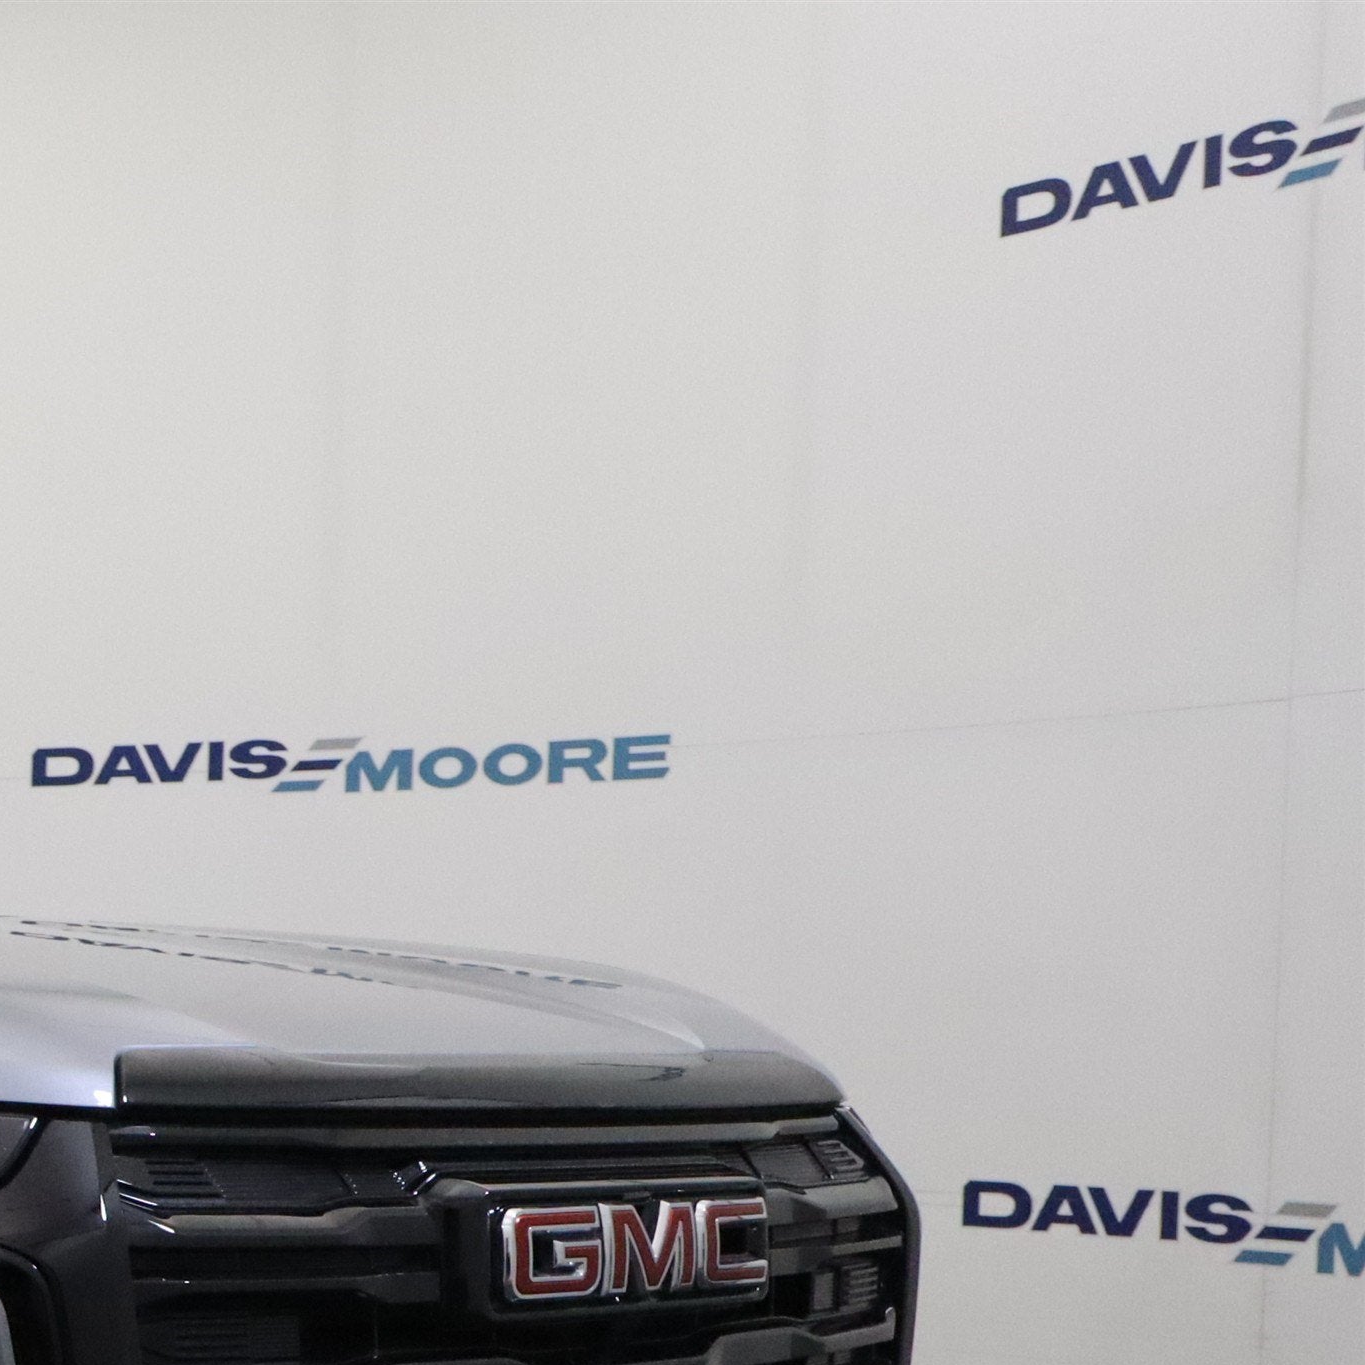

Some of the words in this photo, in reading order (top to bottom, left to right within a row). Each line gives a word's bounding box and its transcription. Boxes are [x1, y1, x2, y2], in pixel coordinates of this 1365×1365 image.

[1000, 119, 1298, 237] DAVIS
[31, 739, 289, 787] DAVIS
[344, 735, 671, 793] MOORE
[501, 1197, 768, 1300] GMC
[962, 1180, 1253, 1244] DAVIS
